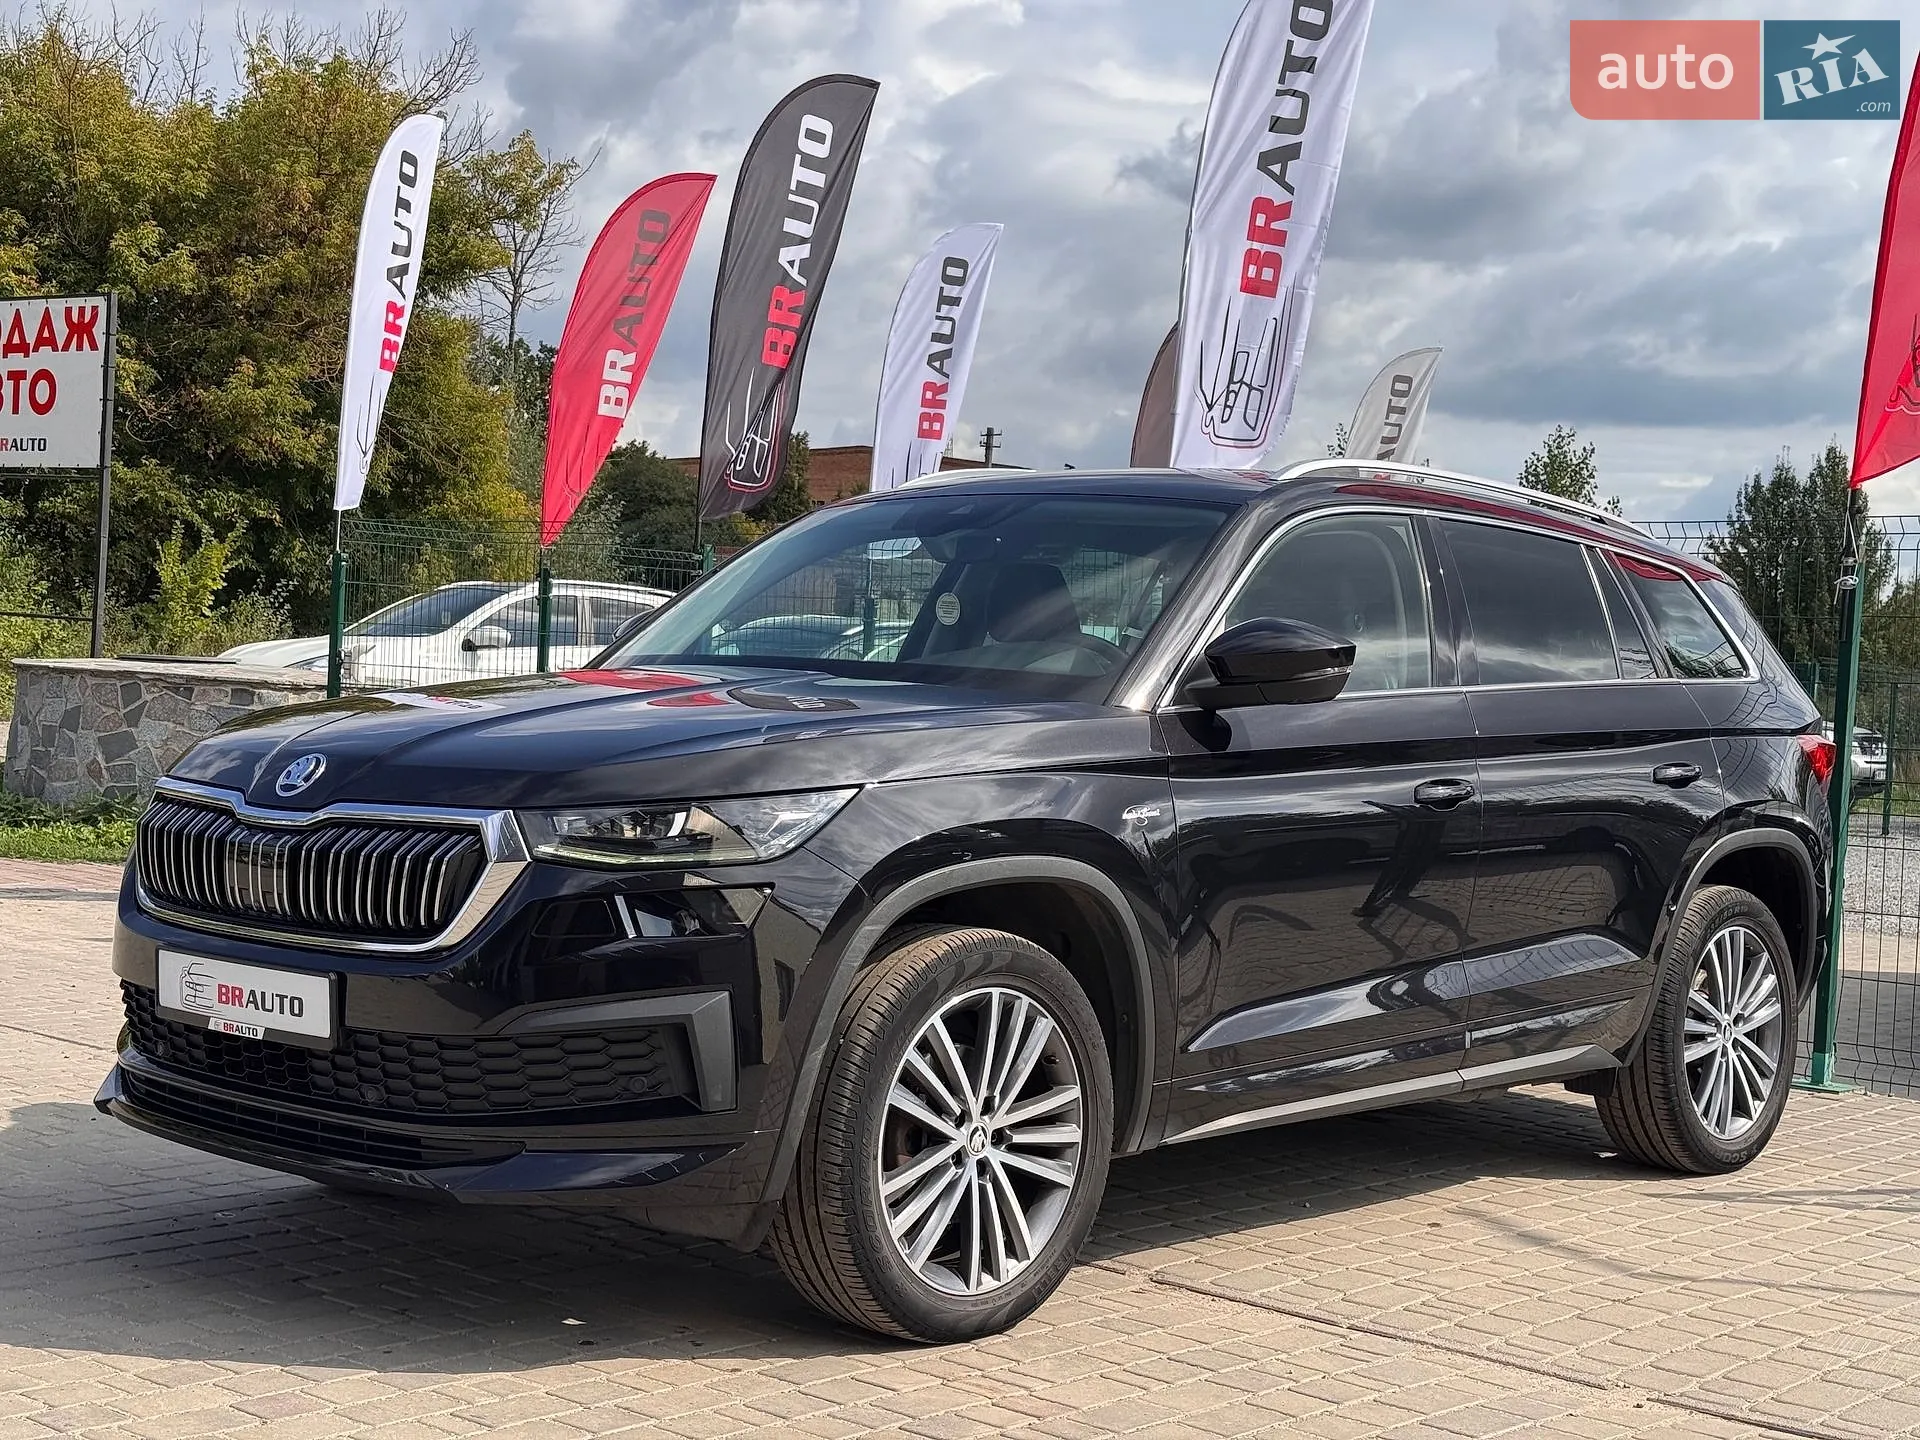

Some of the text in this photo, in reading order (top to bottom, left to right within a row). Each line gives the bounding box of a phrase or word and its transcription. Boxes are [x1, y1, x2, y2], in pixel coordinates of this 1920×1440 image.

[762, 114, 834, 369] BRAUTO
[1240, 0, 1334, 299] BRAUTO
[0, 305, 99, 359] ДАЖ
[379, 150, 418, 374] BRAUTO
[597, 208, 672, 419] BRAUTO
[917, 256, 969, 440] BRAUTO
[0, 368, 57, 416] ТО
[217, 983, 304, 1018] BRAUTO
[223, 1022, 258, 1037] BRAUTO
